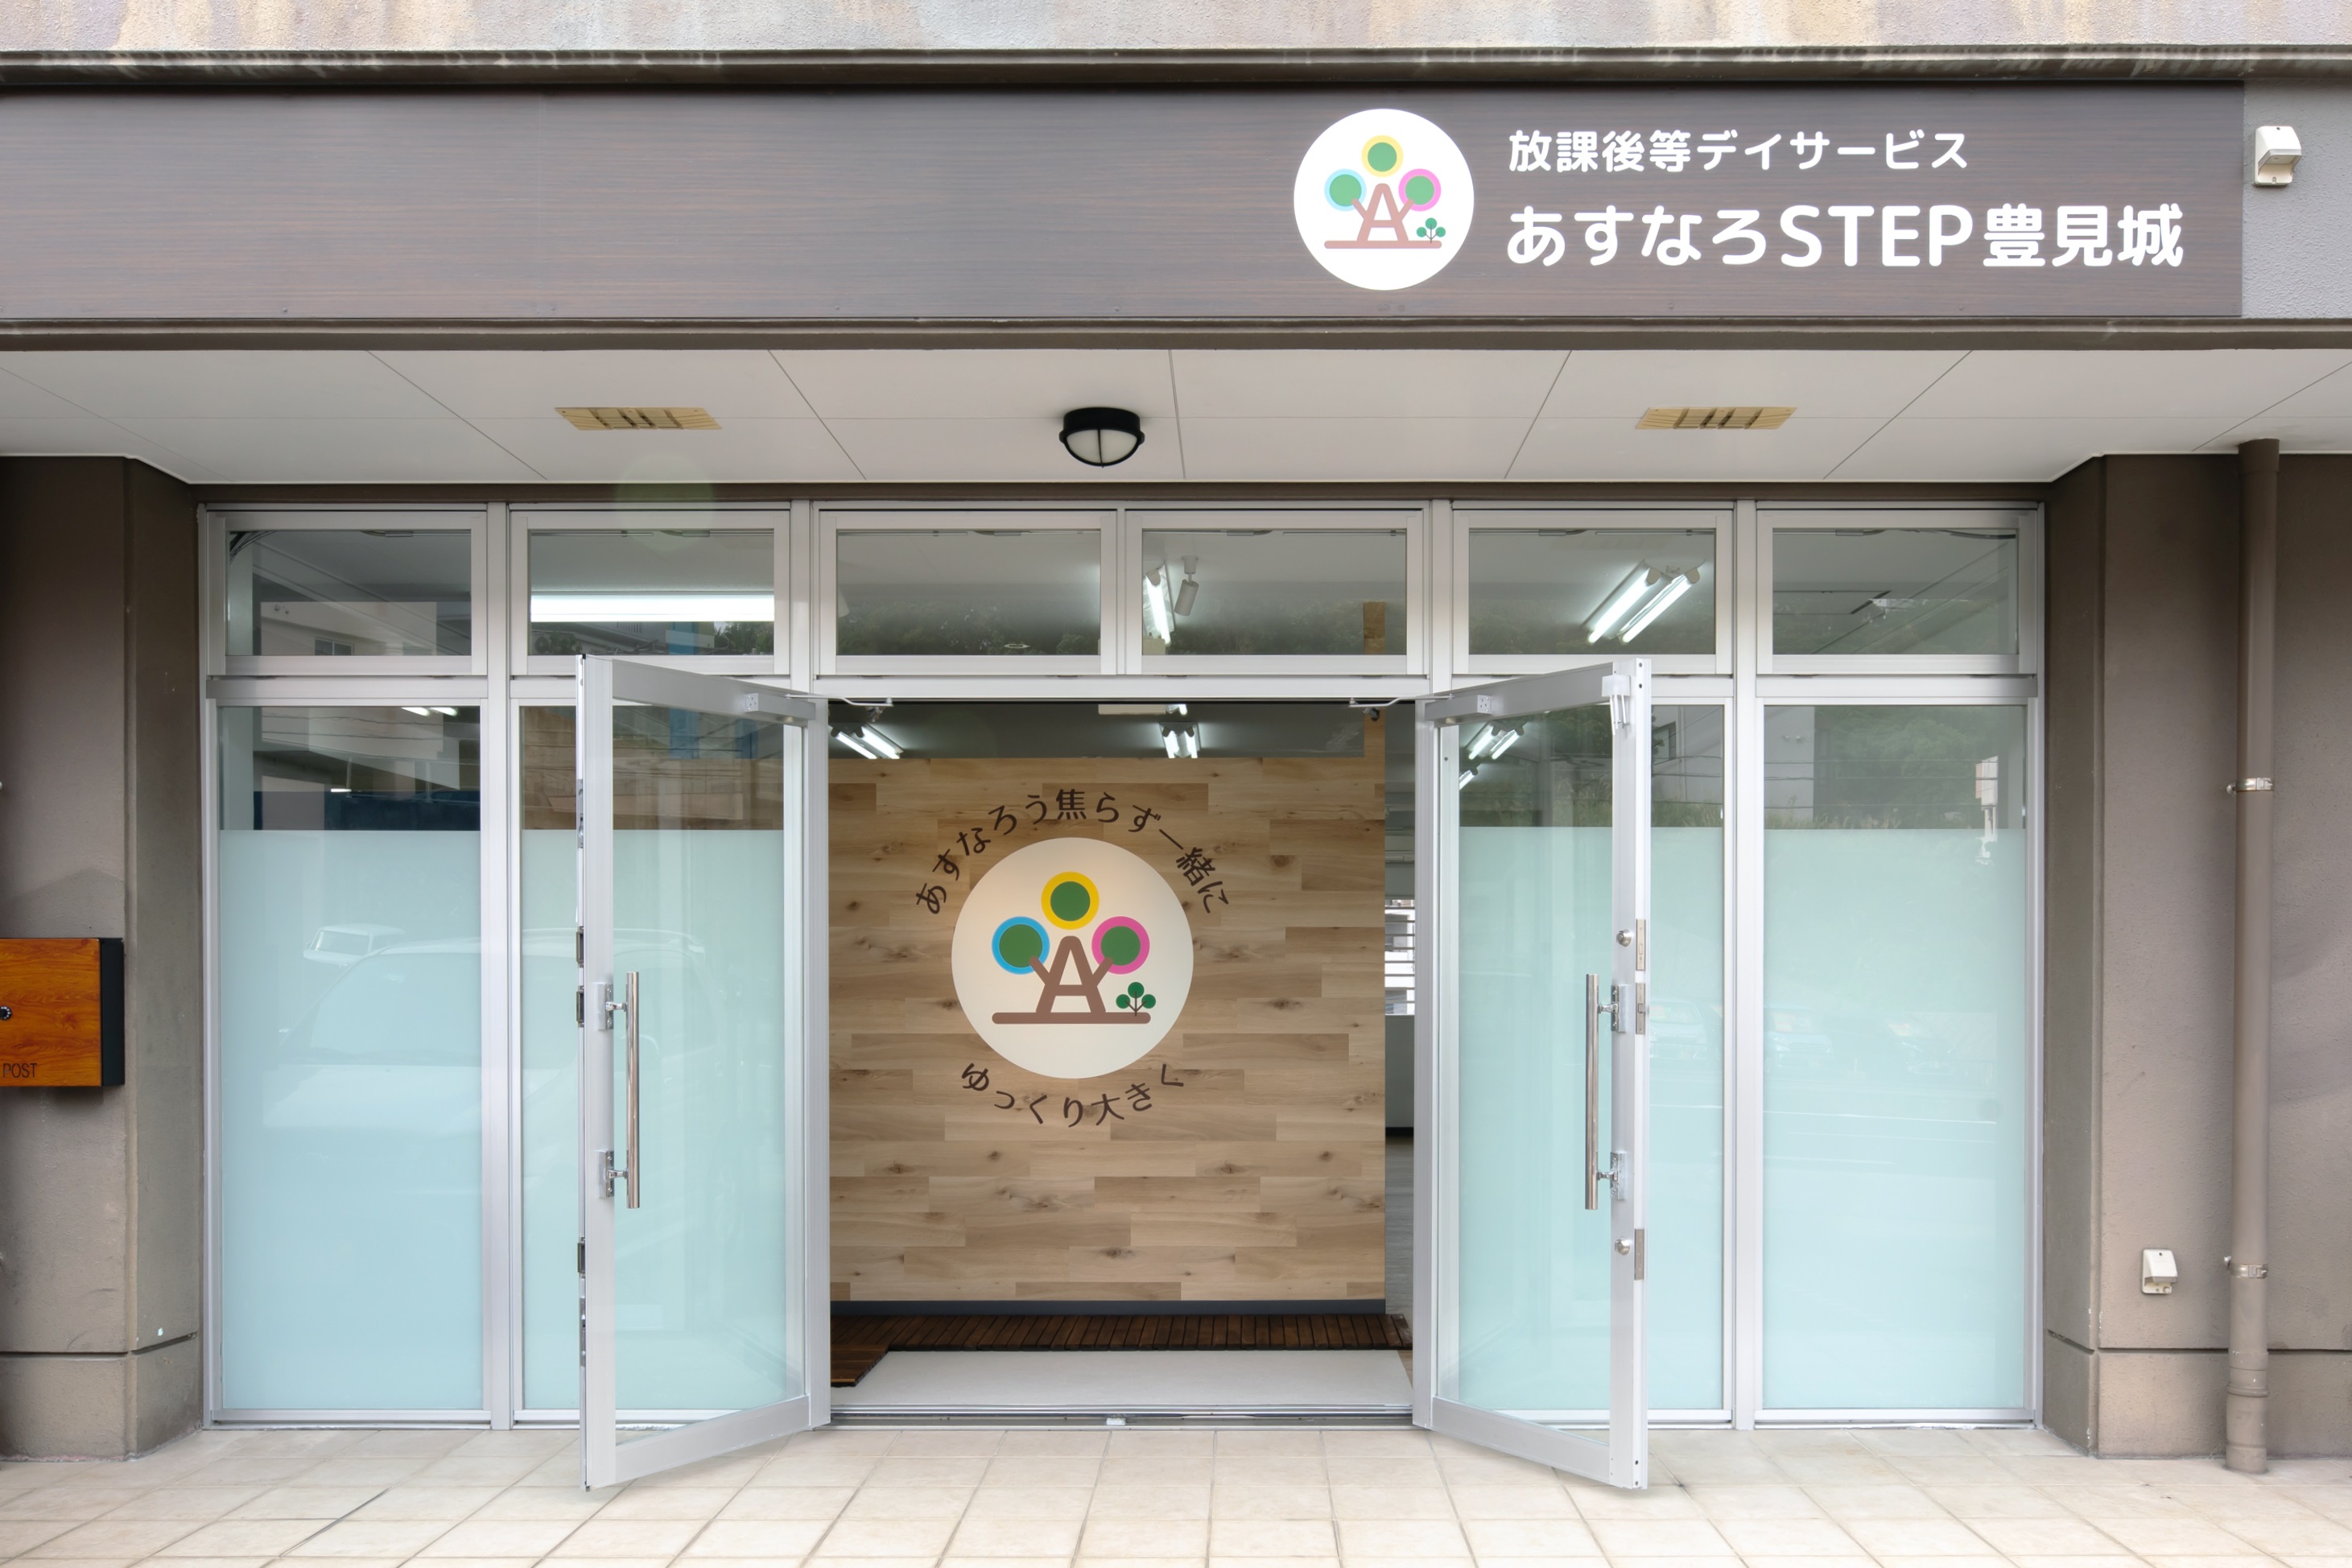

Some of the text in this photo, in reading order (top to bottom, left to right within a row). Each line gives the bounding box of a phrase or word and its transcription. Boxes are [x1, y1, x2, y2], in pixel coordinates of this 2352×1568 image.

[1508, 129, 1967, 173] 放課後等デイサービス
[1507, 203, 2184, 268] あすなろSTEP豊見城
[915, 788, 1229, 914] あすなろう焦らず一緒に
[2, 1063, 38, 1079] POST
[961, 1063, 1185, 1129] ゆっくり大きく
